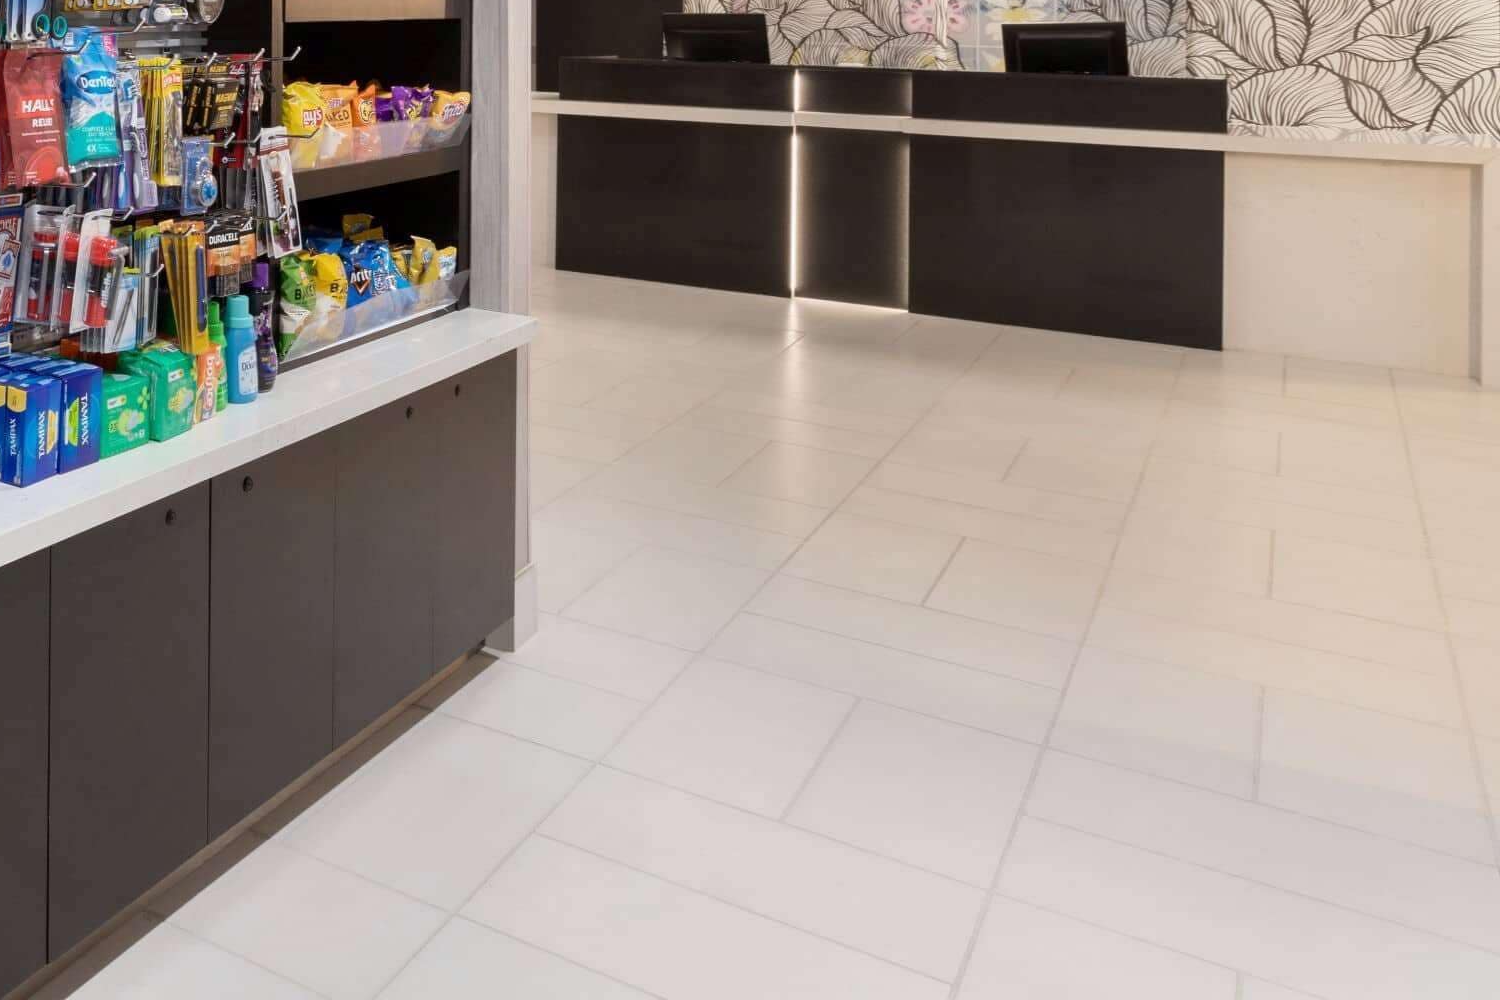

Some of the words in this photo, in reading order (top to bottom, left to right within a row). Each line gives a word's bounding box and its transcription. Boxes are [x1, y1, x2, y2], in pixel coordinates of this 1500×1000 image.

[208, 232, 239, 245] DURACELL
[38, 410, 46, 459] TAMPAX
[81, 392, 89, 445] TAMPAX
